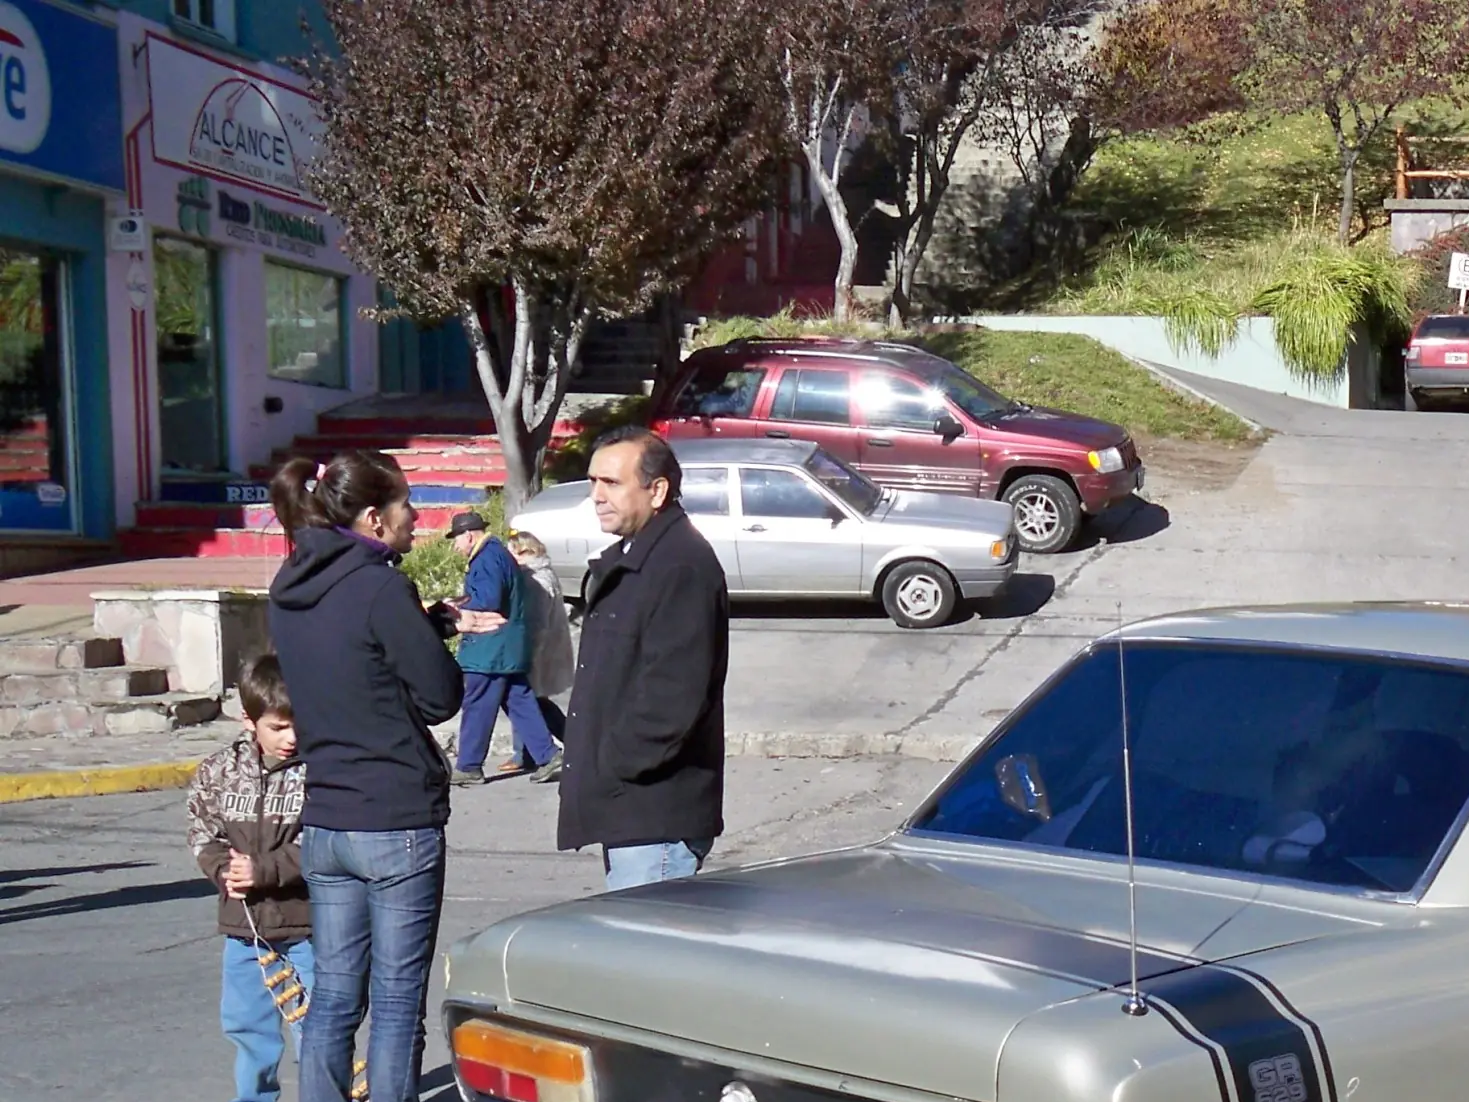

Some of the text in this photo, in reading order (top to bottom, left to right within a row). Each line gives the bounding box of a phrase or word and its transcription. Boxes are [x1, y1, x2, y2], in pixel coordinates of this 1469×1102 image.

[0, 51, 27, 121] e
[200, 110, 286, 166] ALCANCE
[226, 486, 269, 502] RED
